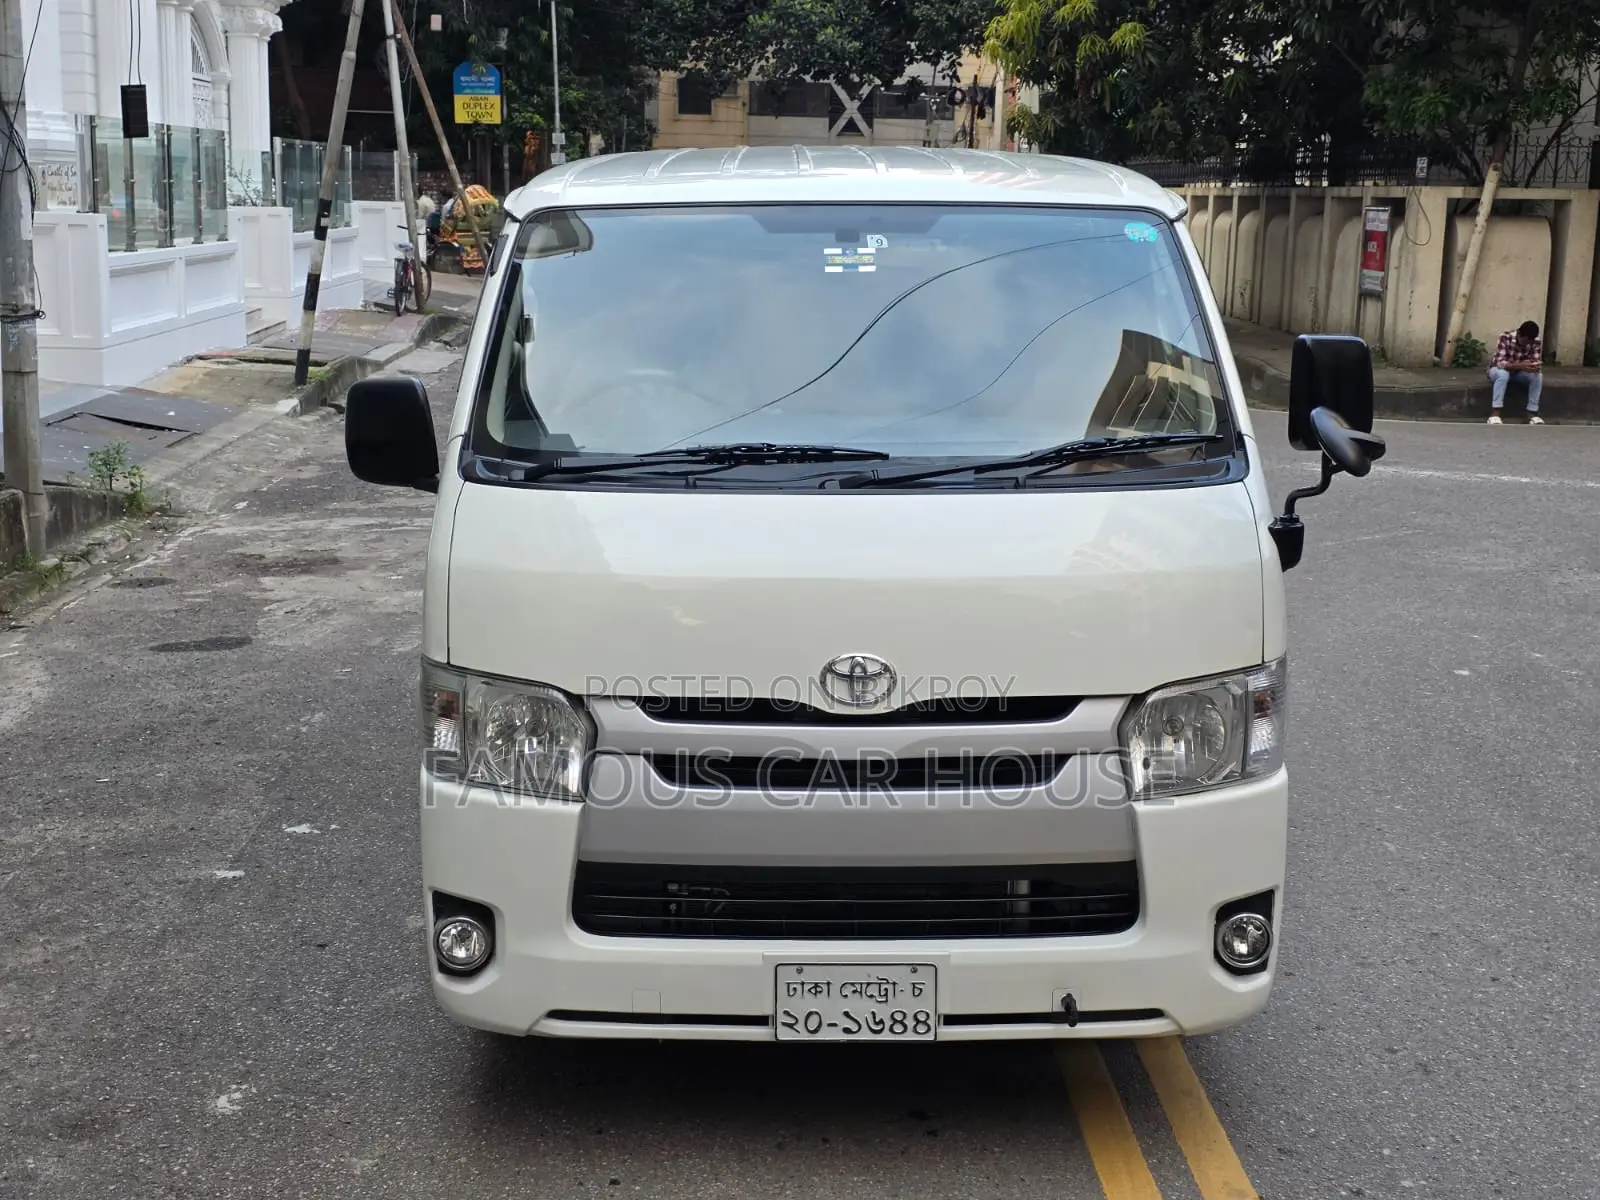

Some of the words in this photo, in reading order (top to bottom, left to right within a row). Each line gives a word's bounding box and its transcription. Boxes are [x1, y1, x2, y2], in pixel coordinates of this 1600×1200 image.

[462, 102, 496, 110] DUPLEX
[465, 110, 493, 119] TOWN
[784, 980, 832, 998] ঢাকা
[780, 1009, 932, 1035] ২০-১৬৪৪
